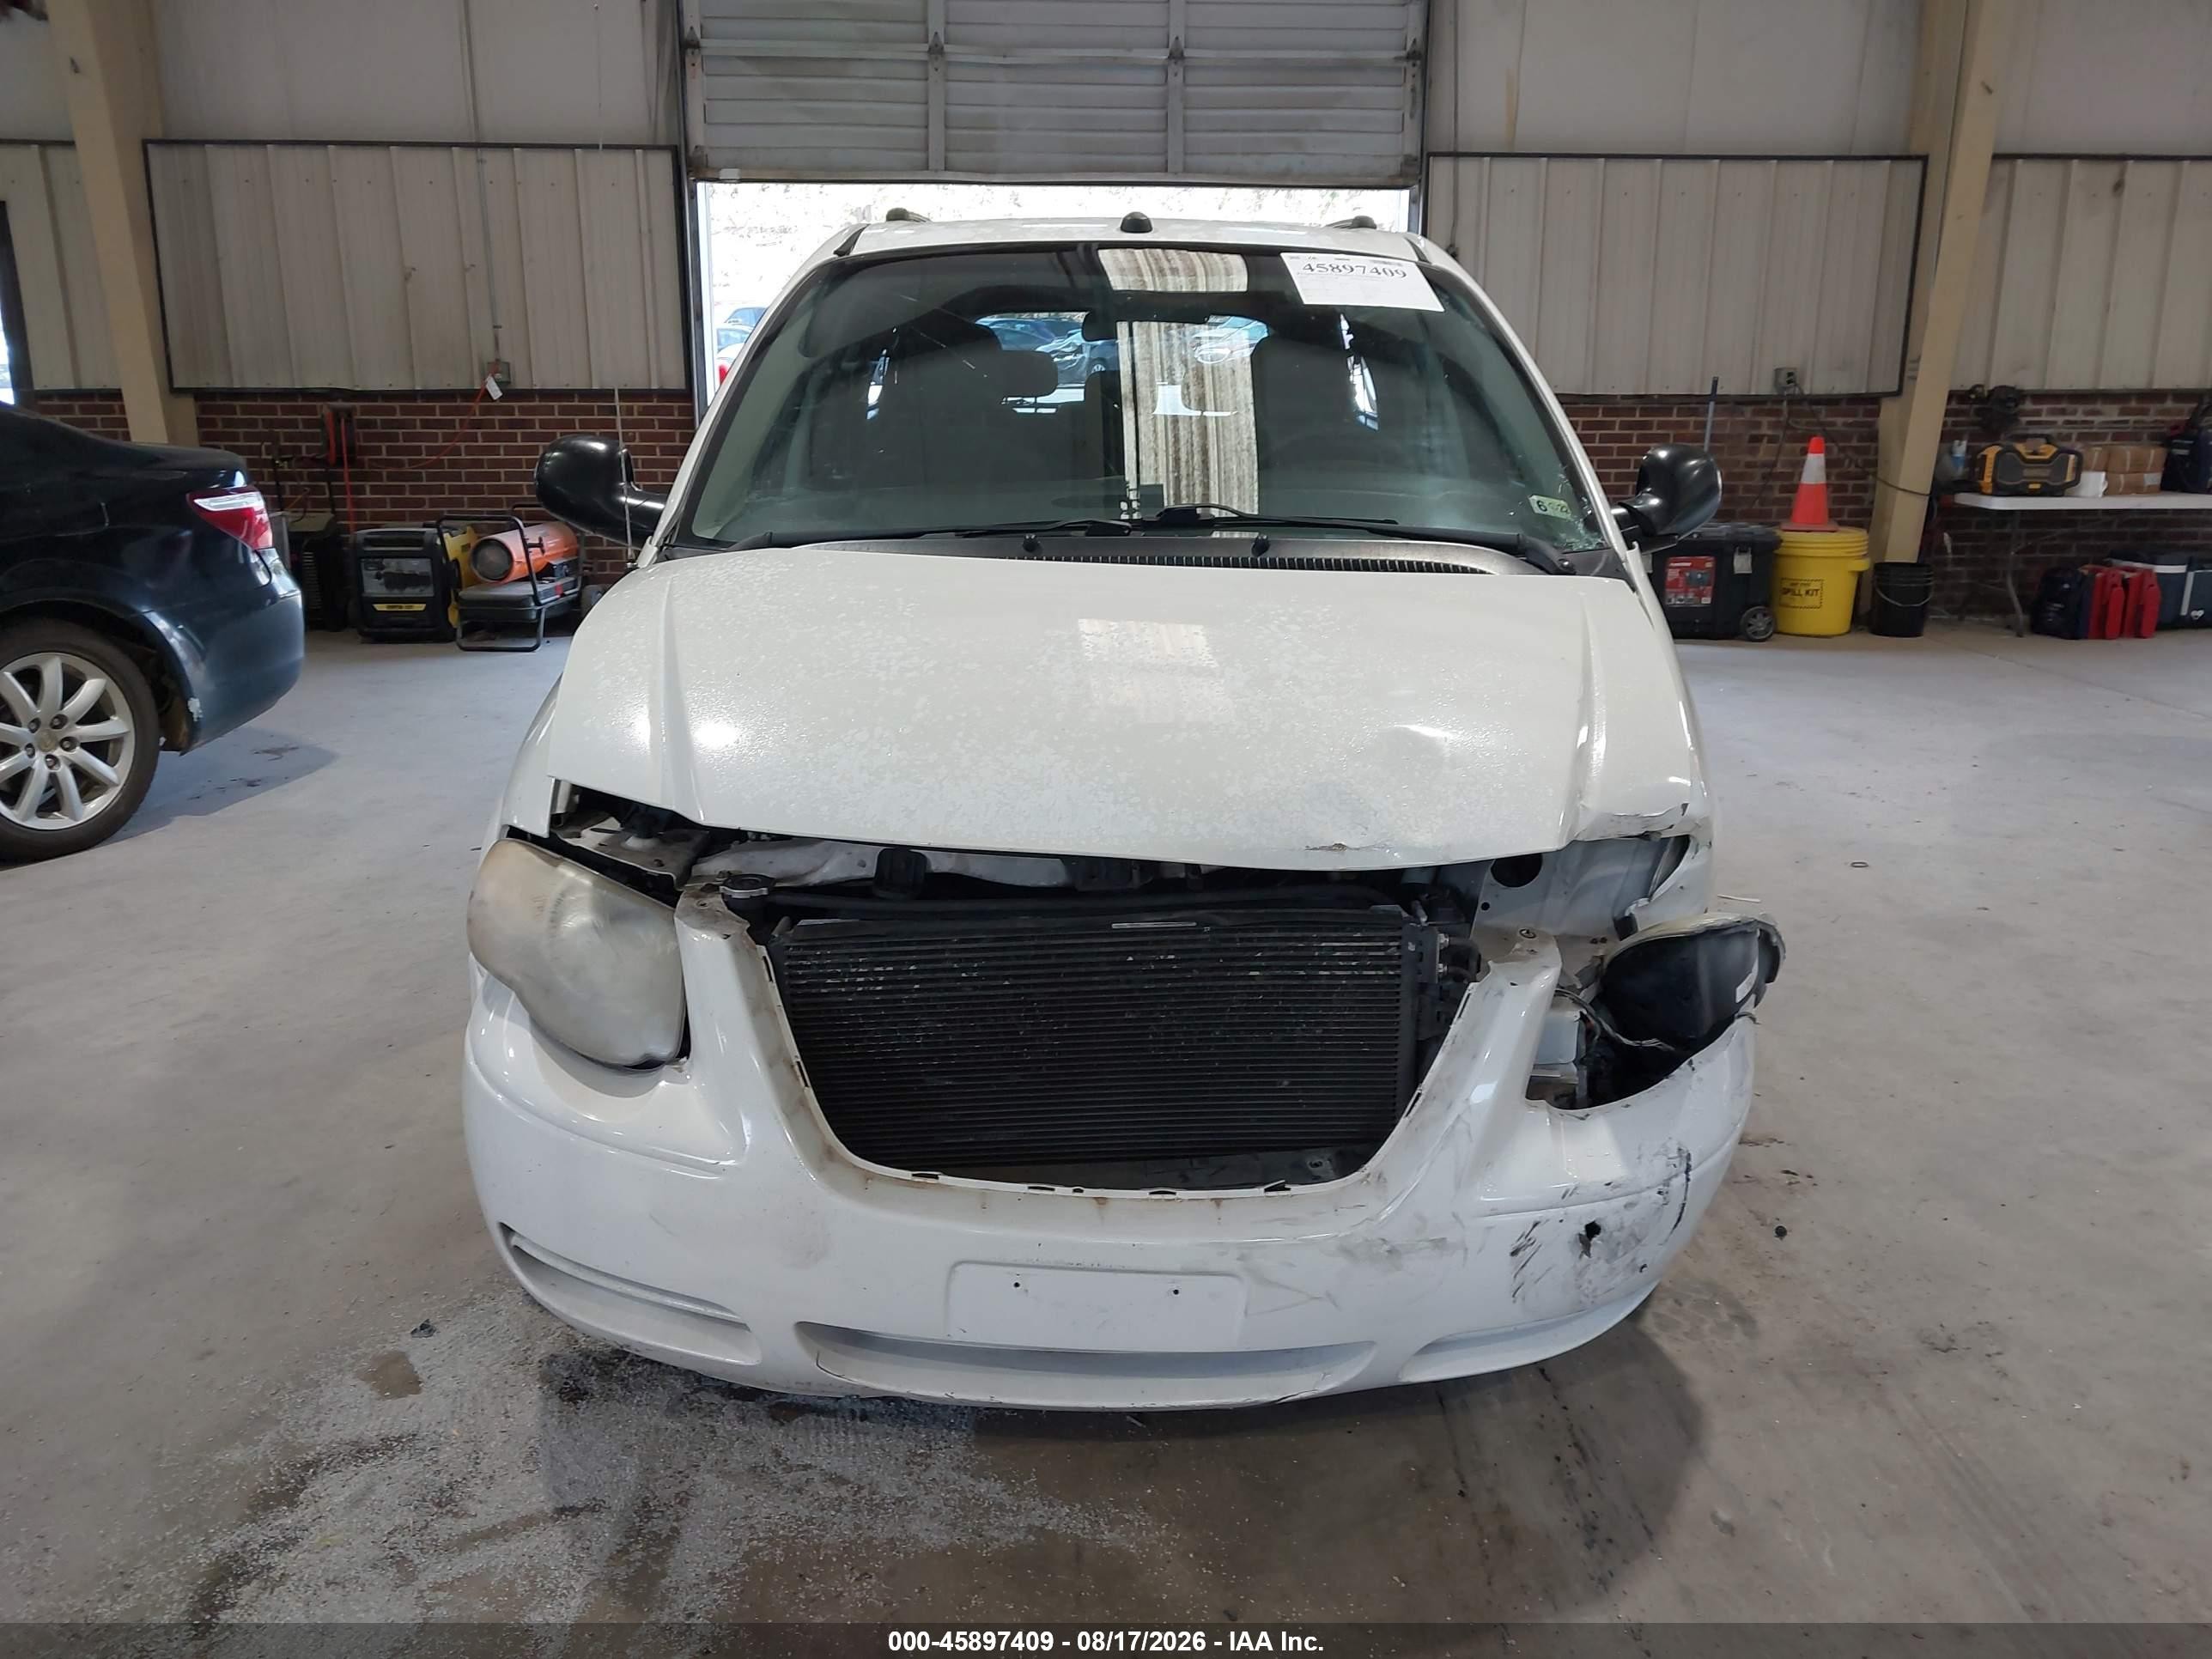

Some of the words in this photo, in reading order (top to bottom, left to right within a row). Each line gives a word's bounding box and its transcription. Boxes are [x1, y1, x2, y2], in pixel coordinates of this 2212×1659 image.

[1302, 263, 1407, 279] 45897409
[1536, 500, 1548, 513] 6
[1805, 588, 1820, 598] KIT
